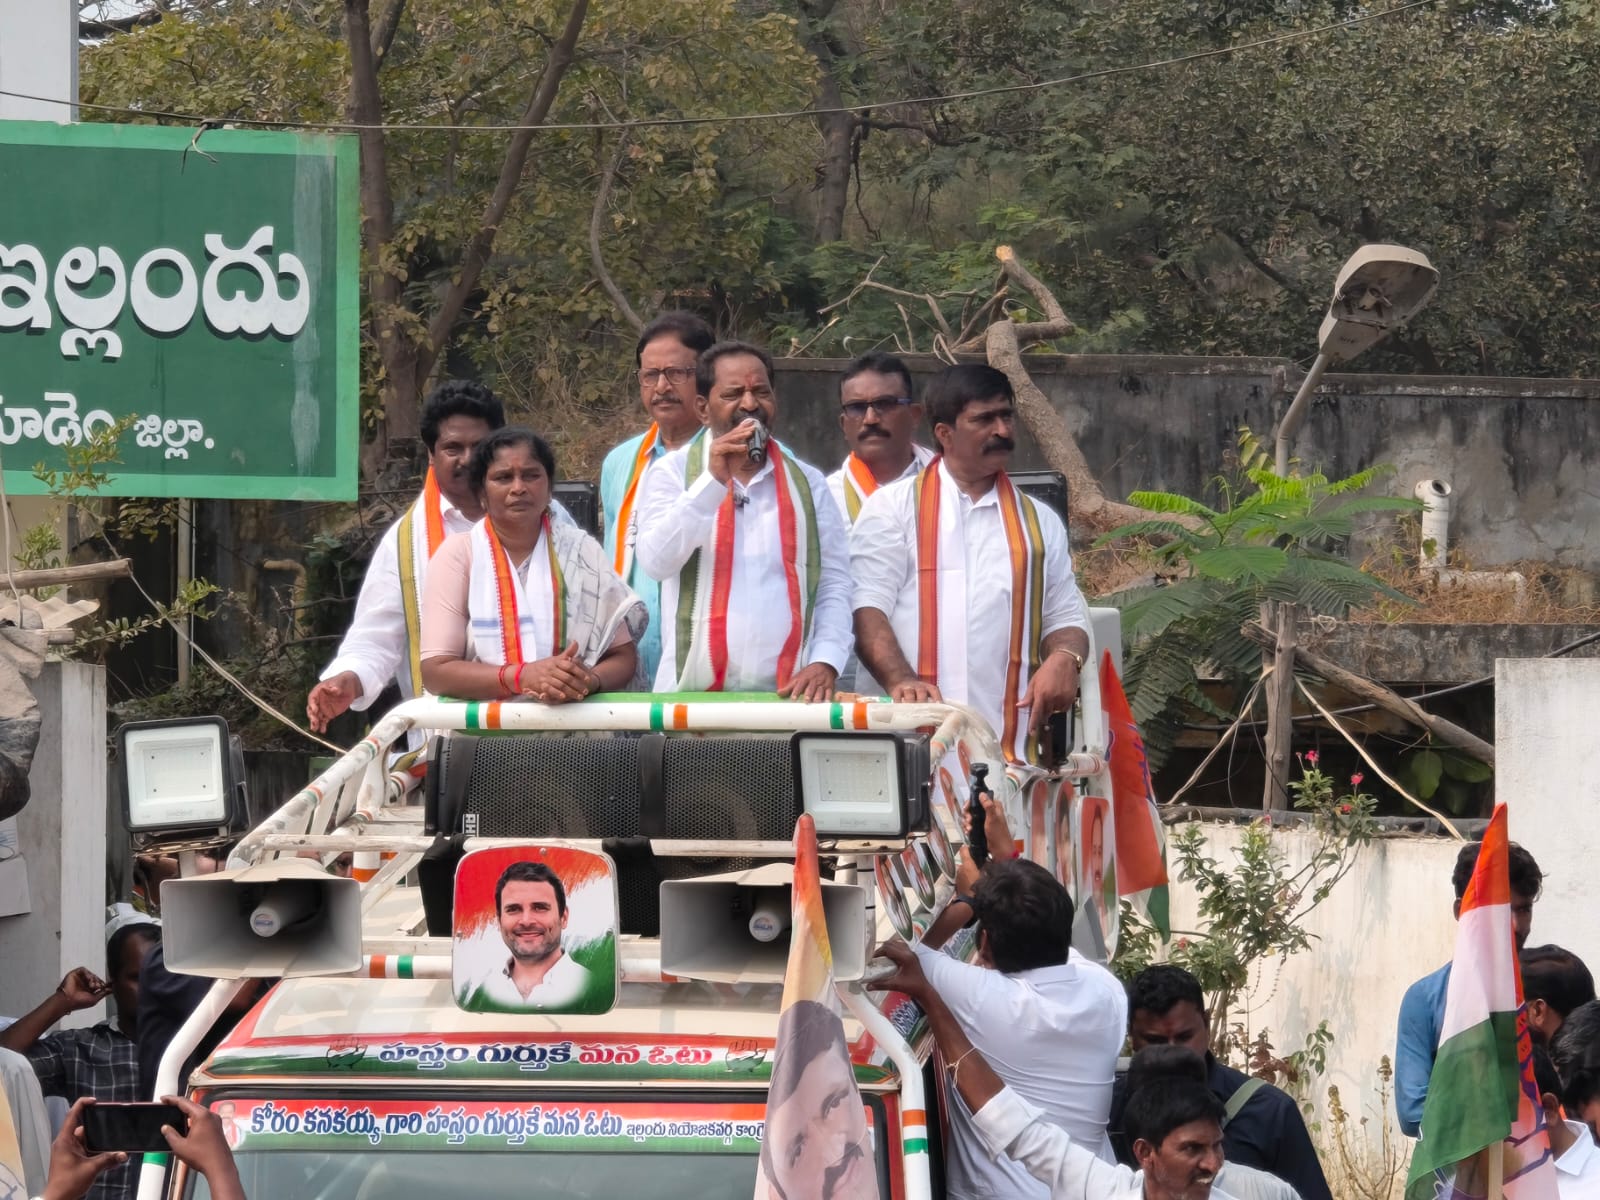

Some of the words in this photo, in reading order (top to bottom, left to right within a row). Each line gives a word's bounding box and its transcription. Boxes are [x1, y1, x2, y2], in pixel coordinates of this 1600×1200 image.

[0, 225, 310, 358] ఇల్లందు
[579, 1045, 640, 1064] మన
[648, 1046, 712, 1065] ఓటు
[251, 1102, 299, 1133] కోరం
[304, 1108, 380, 1144] కనకయ్య
[386, 1113, 422, 1134] గారి
[544, 1110, 579, 1135] మన
[584, 1111, 622, 1135] ఓటు
[626, 1122, 666, 1141] ఇల్లందు
